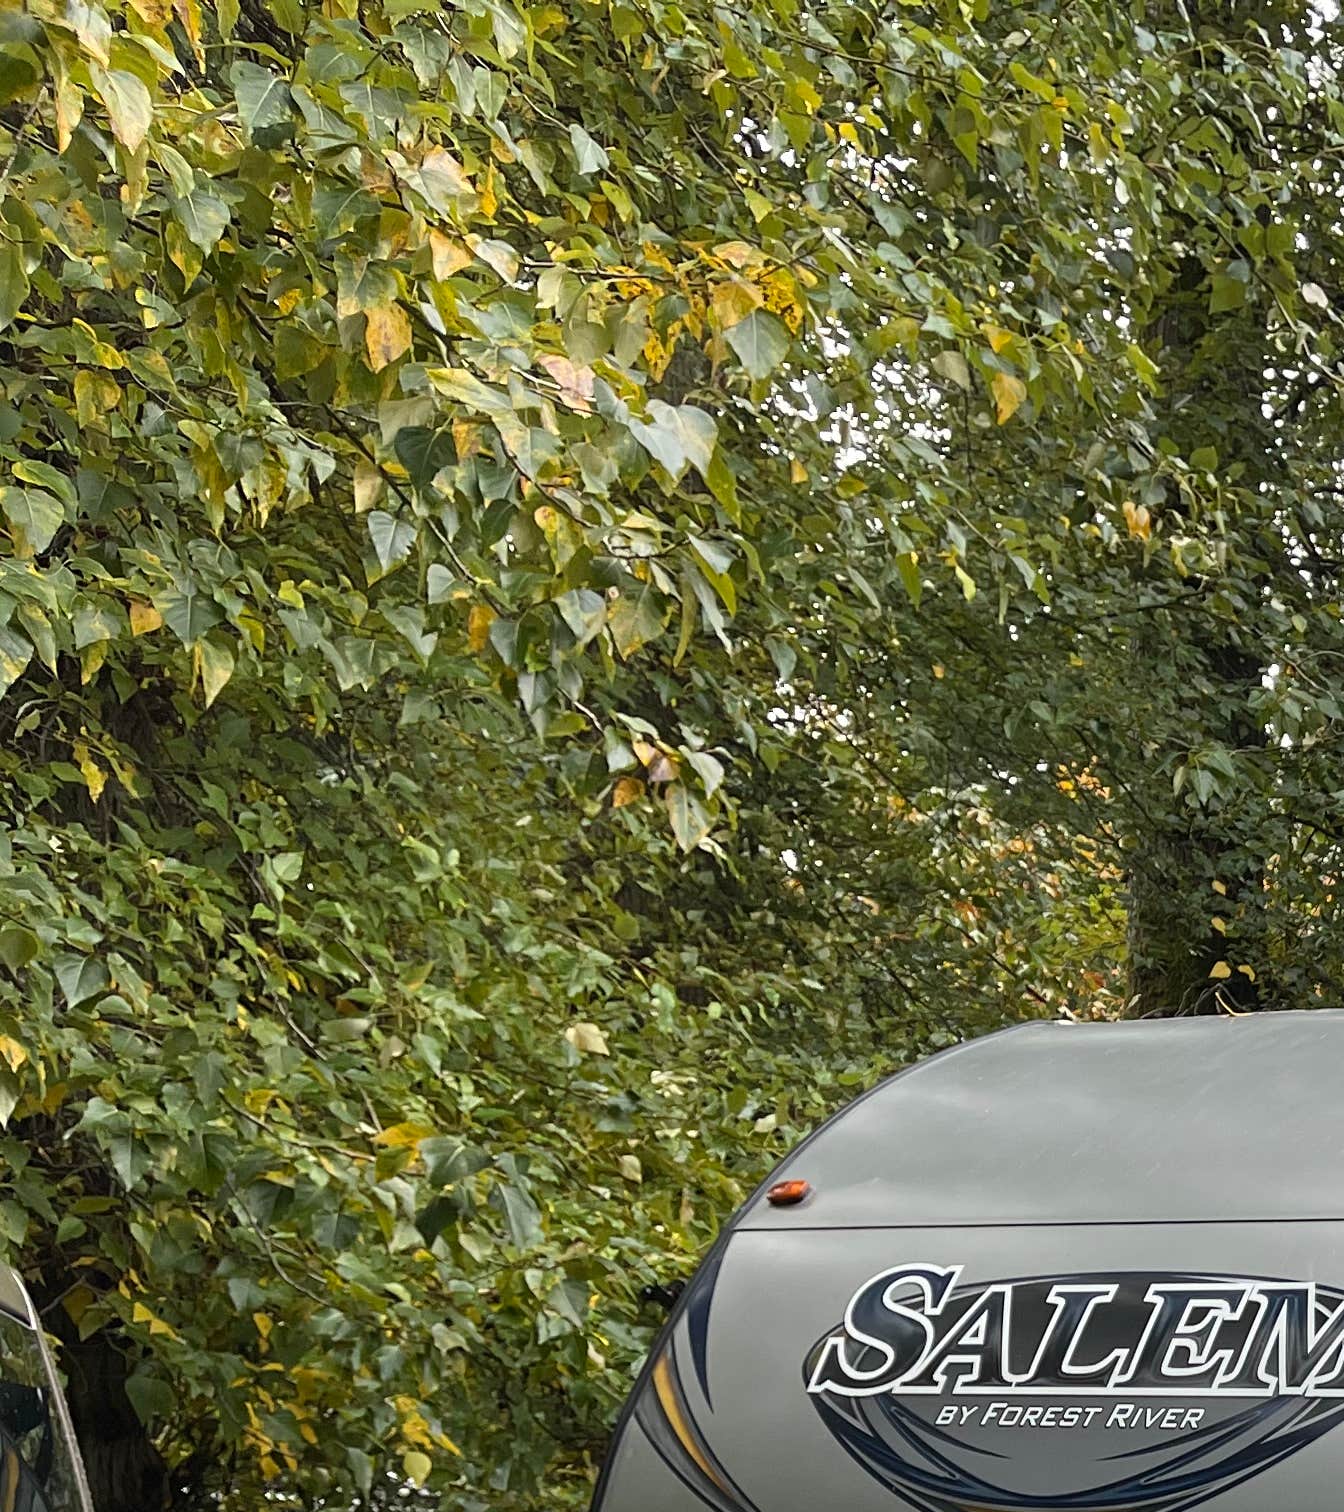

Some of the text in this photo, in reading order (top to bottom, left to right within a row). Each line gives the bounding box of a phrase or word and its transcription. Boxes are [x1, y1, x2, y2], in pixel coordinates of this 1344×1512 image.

[935, 1403, 1206, 1429] BY FOREST RIVER
